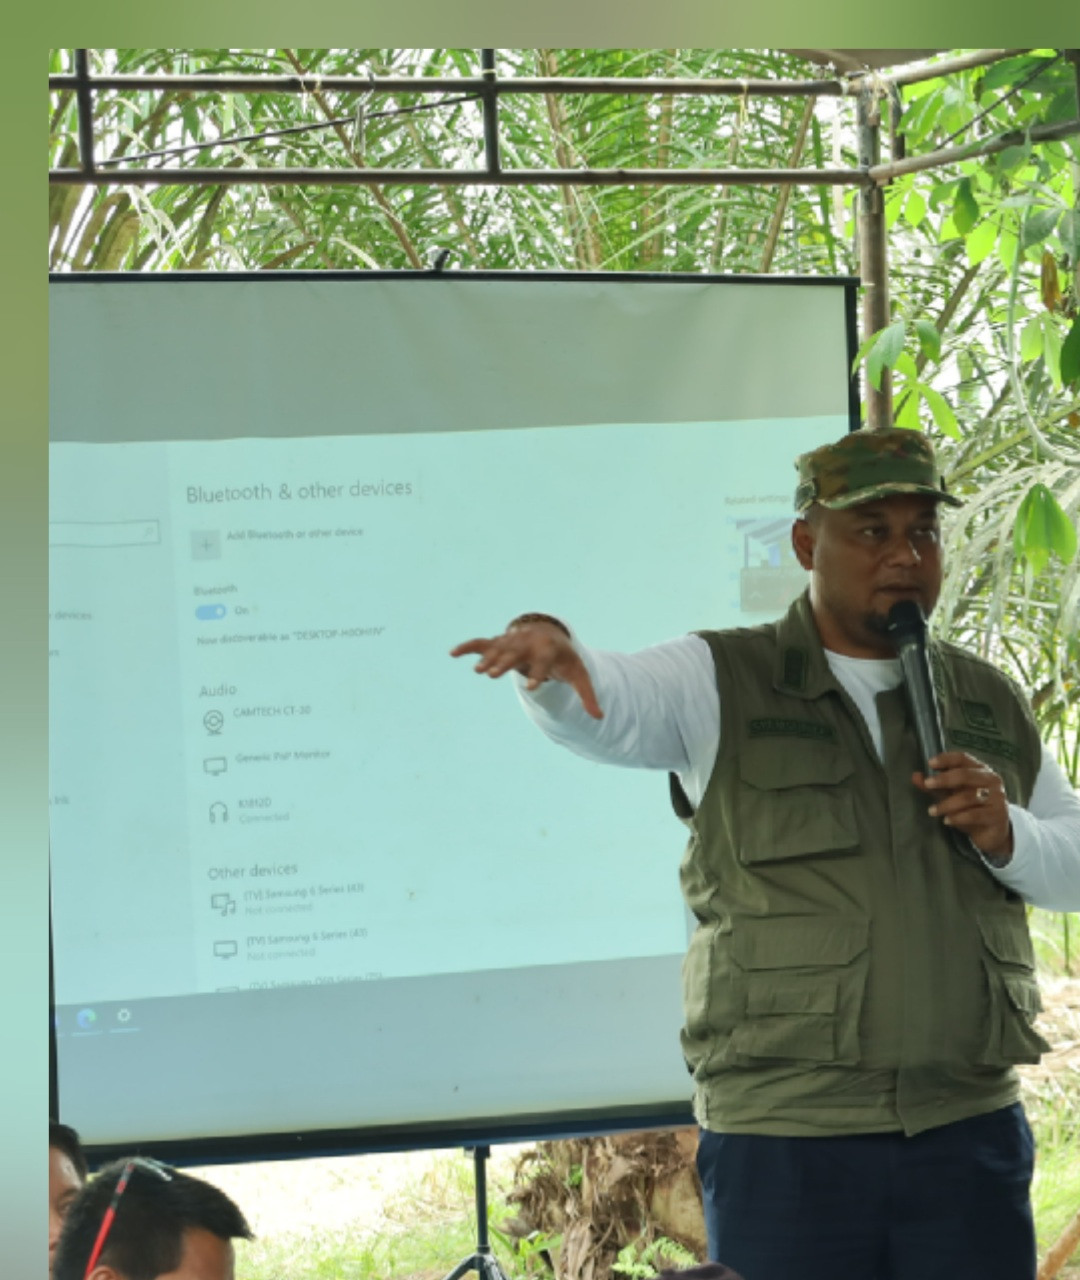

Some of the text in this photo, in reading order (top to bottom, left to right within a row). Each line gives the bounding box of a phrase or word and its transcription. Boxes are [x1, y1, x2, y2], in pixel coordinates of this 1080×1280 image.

[186, 478, 413, 505] Bluetooth & other devices
[226, 529, 246, 541] Add
[247, 528, 294, 540] Bluetooth
[308, 528, 331, 539] other
[334, 526, 364, 537] device
[193, 583, 238, 596] Bluetooth
[234, 605, 249, 616] On
[196, 634, 218, 646] Now
[219, 631, 277, 644] discoverable
[199, 683, 238, 699] Audio
[233, 706, 281, 719] CAMTECH
[235, 752, 271, 764] Generic
[294, 750, 331, 761] Monitor
[239, 811, 290, 825] Connected
[207, 862, 298, 880] Other devices
[264, 886, 308, 900] Samsung
[318, 883, 344, 895] Series
[245, 902, 313, 916] Not connected
[267, 931, 310, 946] Samsung
[320, 929, 347, 942] Series
[247, 947, 316, 961] Not connected
